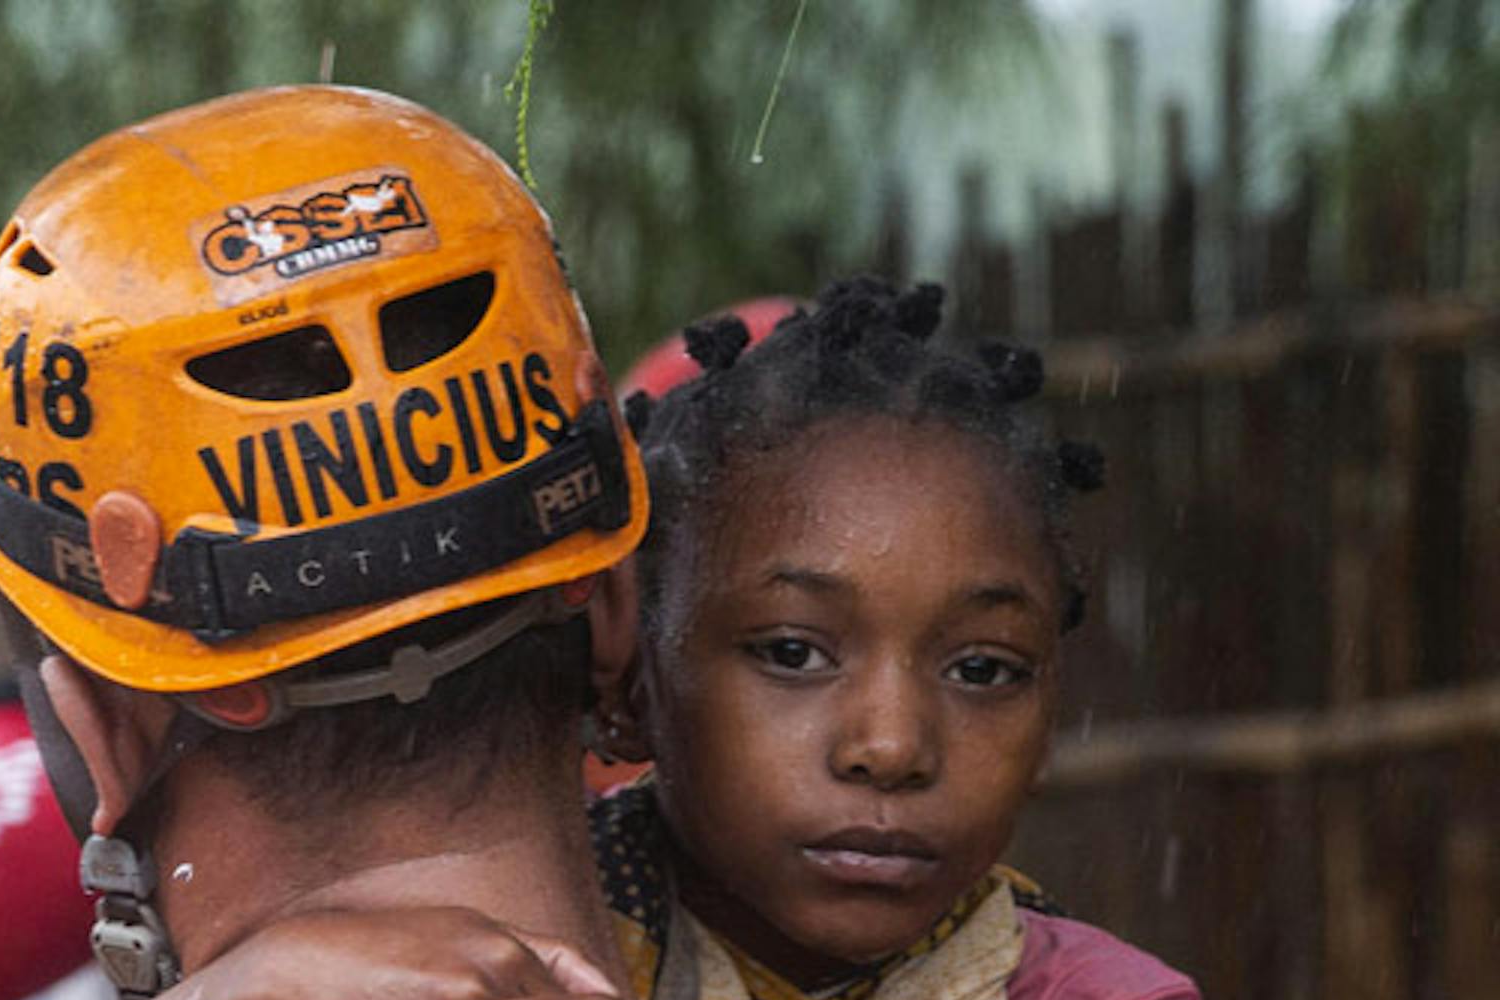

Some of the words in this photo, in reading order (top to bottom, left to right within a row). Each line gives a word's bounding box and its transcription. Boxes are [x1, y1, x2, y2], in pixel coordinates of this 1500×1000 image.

[3, 332, 92, 440] 18
[197, 352, 573, 538] VINICIUS
[247, 526, 461, 597] ACTIK
